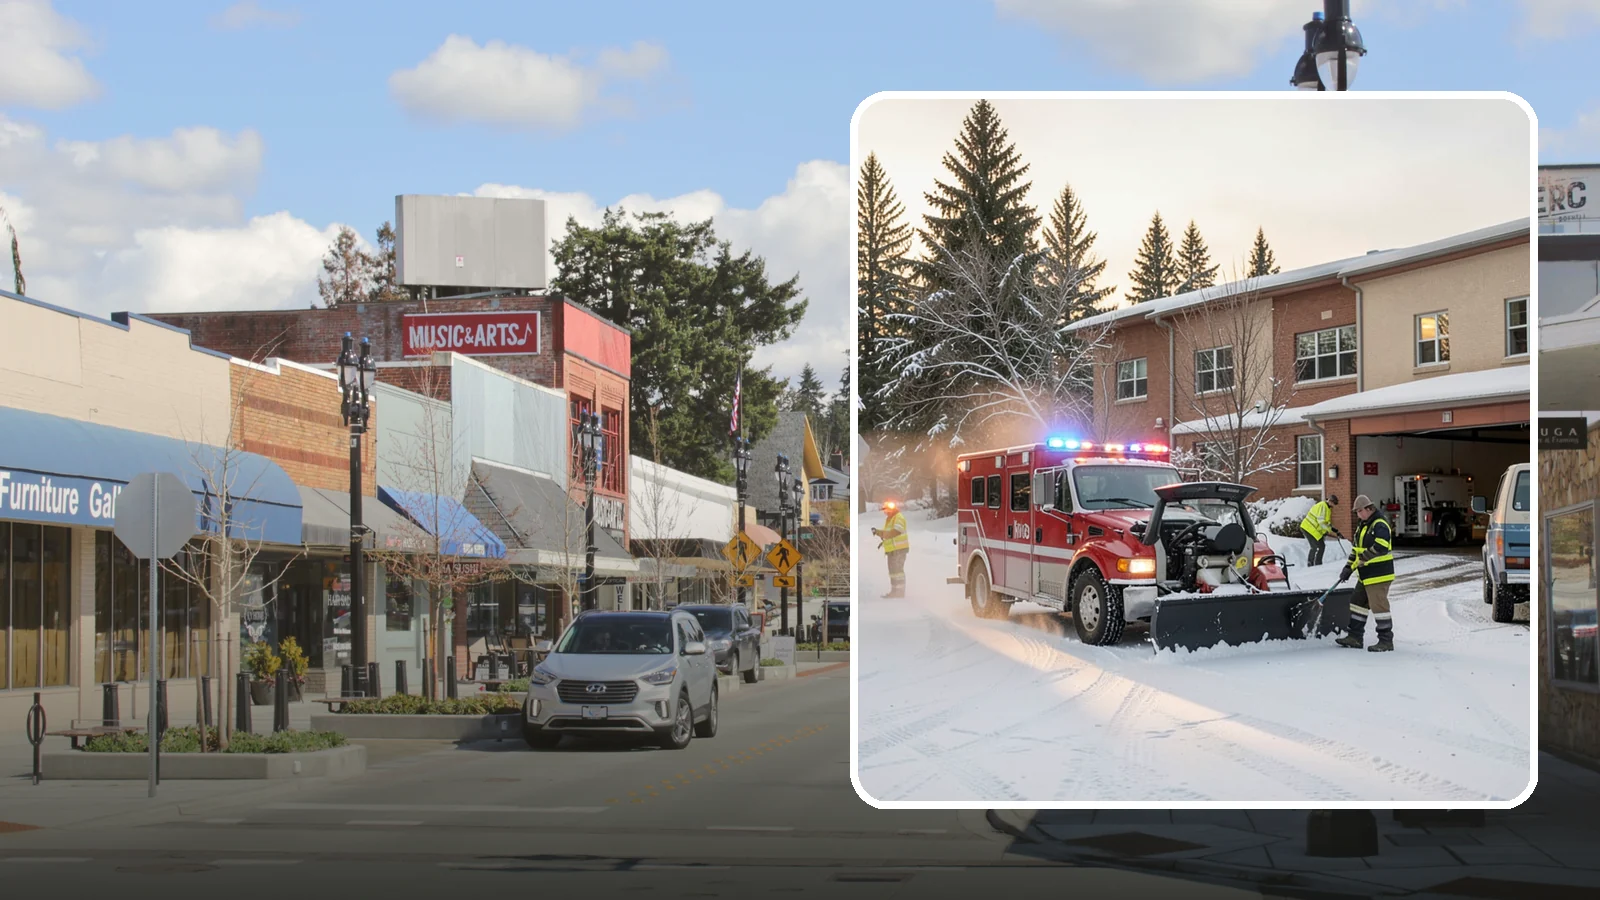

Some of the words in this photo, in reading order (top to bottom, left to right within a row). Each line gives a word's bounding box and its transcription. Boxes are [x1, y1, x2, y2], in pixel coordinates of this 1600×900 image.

[0, 471, 80, 516] Furniture
[89, 482, 122, 519] Gal
[453, 562, 480, 575] SUSHI
